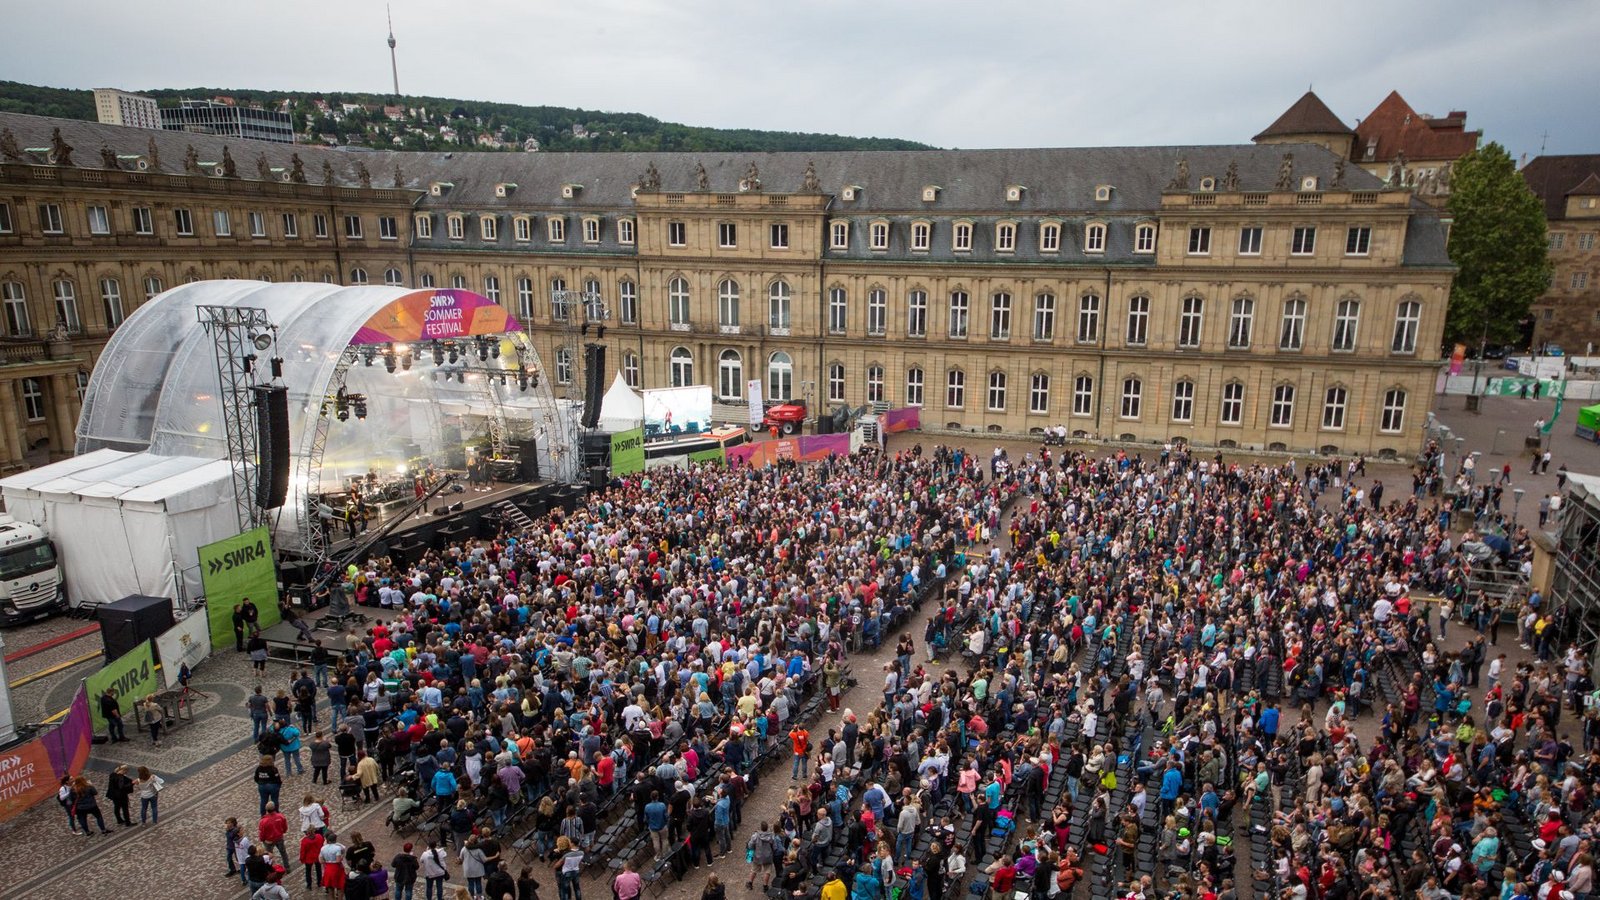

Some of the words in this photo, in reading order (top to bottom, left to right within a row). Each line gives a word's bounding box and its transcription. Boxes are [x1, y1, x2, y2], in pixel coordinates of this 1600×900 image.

[430, 295, 448, 307] SWR
[424, 308, 464, 321] SOMMER
[426, 322, 464, 335] FESTIVAL
[621, 436, 641, 451] SWR4
[223, 540, 266, 571] SWR4
[110, 659, 150, 701] SWR4
[0, 777, 36, 802] TIVAL
